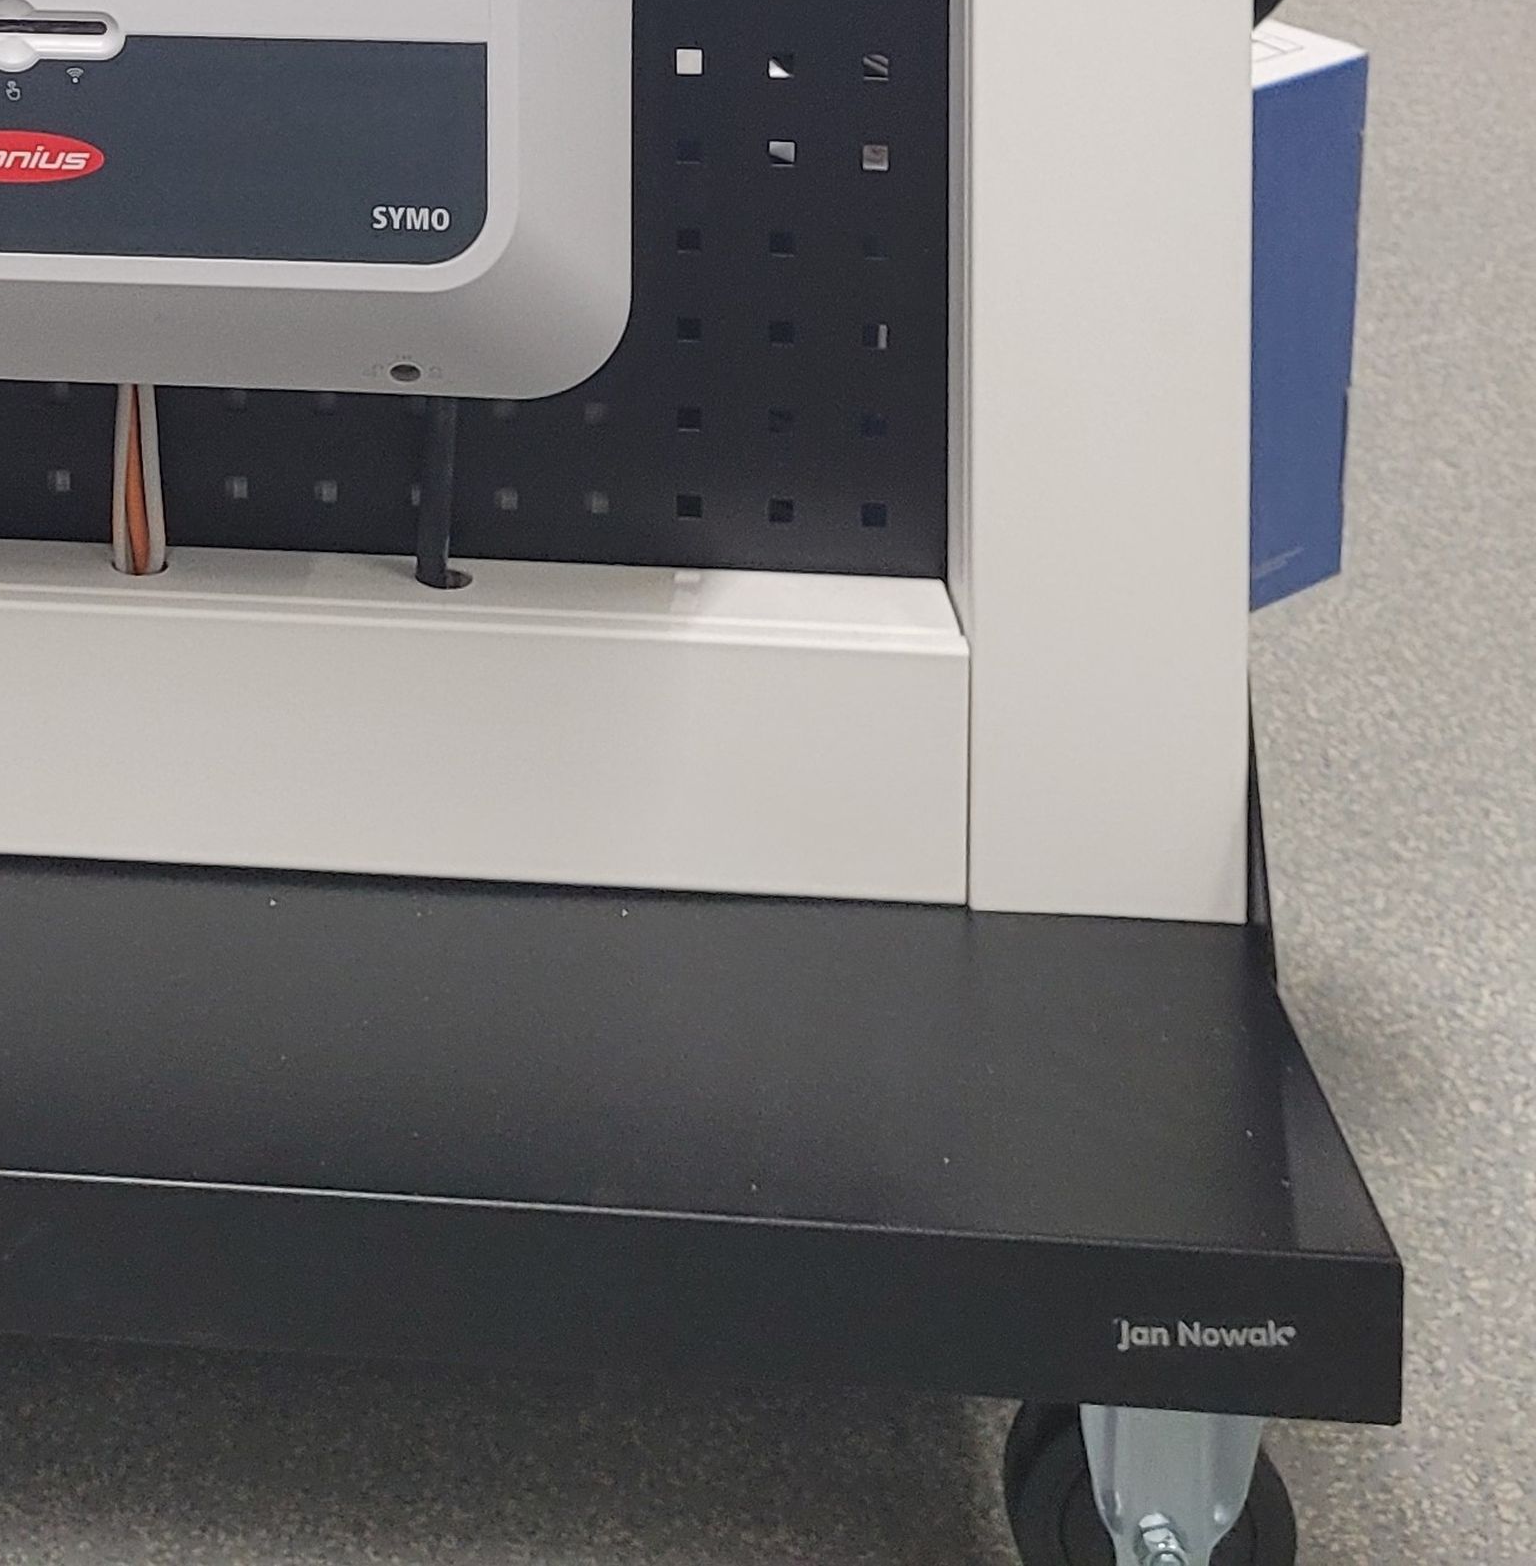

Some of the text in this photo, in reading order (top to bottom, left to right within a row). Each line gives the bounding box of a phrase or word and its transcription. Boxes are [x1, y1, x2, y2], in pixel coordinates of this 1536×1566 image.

[372, 206, 451, 231] SYMO
[1116, 1319, 1297, 1351] Jan Nowak
